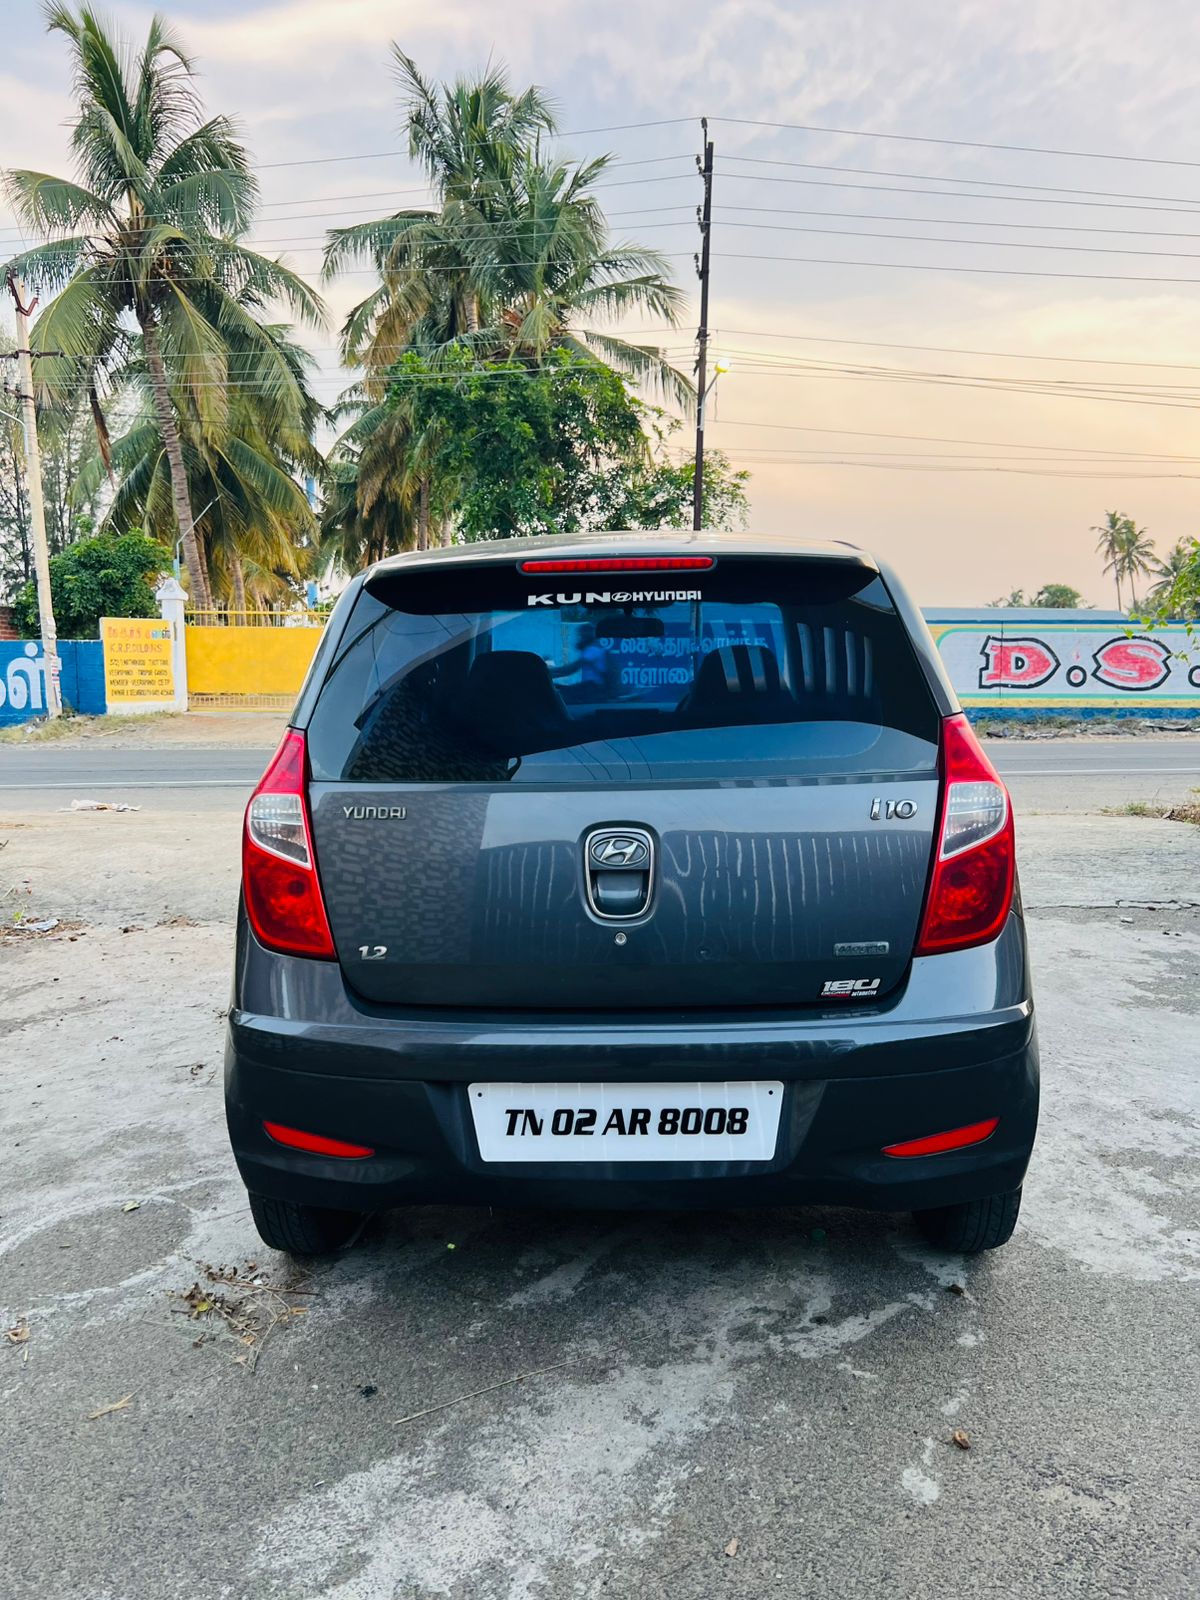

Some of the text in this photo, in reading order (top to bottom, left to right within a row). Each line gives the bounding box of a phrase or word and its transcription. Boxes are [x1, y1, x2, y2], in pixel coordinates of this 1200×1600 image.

[528, 590, 702, 606] KUN HYUNDAI
[343, 806, 407, 819] YUNDAI
[869, 797, 918, 820] i10
[505, 1108, 749, 1136] TN 02 AR 8008
